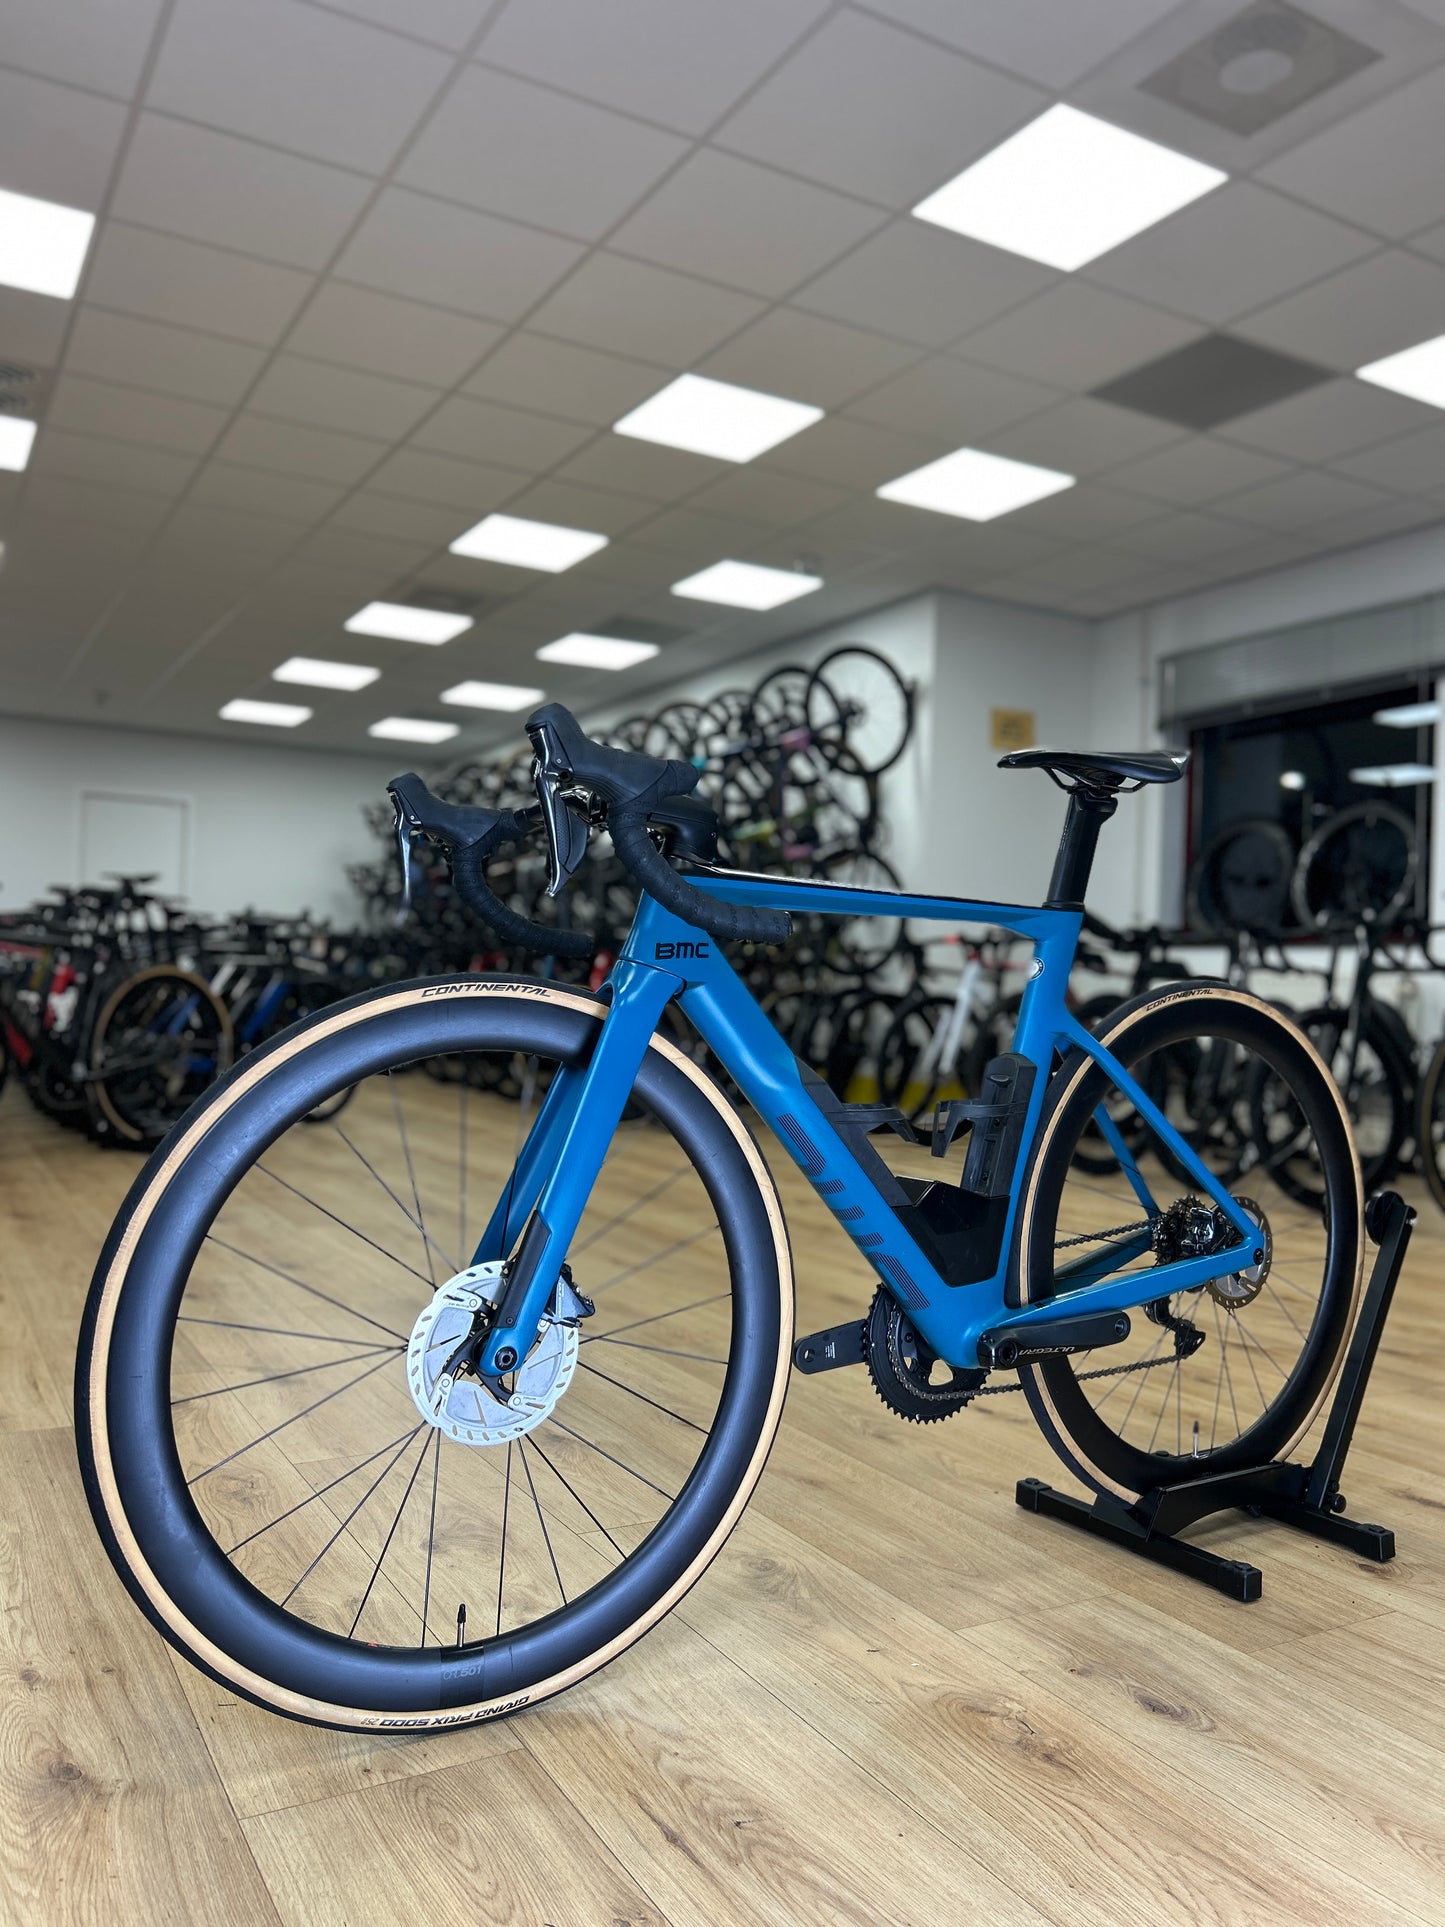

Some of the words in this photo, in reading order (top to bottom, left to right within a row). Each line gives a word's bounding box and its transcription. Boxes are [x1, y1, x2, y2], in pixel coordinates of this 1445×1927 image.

[655, 942, 709, 960] BMC
[421, 983, 551, 998] CONTINENTAL
[1146, 988, 1214, 1012] CONTINENTAL
[1019, 1346, 1075, 1355] ULTEGRA
[474, 1695, 530, 1718] GRAND
[379, 1718, 429, 1727] 5000
[431, 1712, 473, 1726] PRIX
